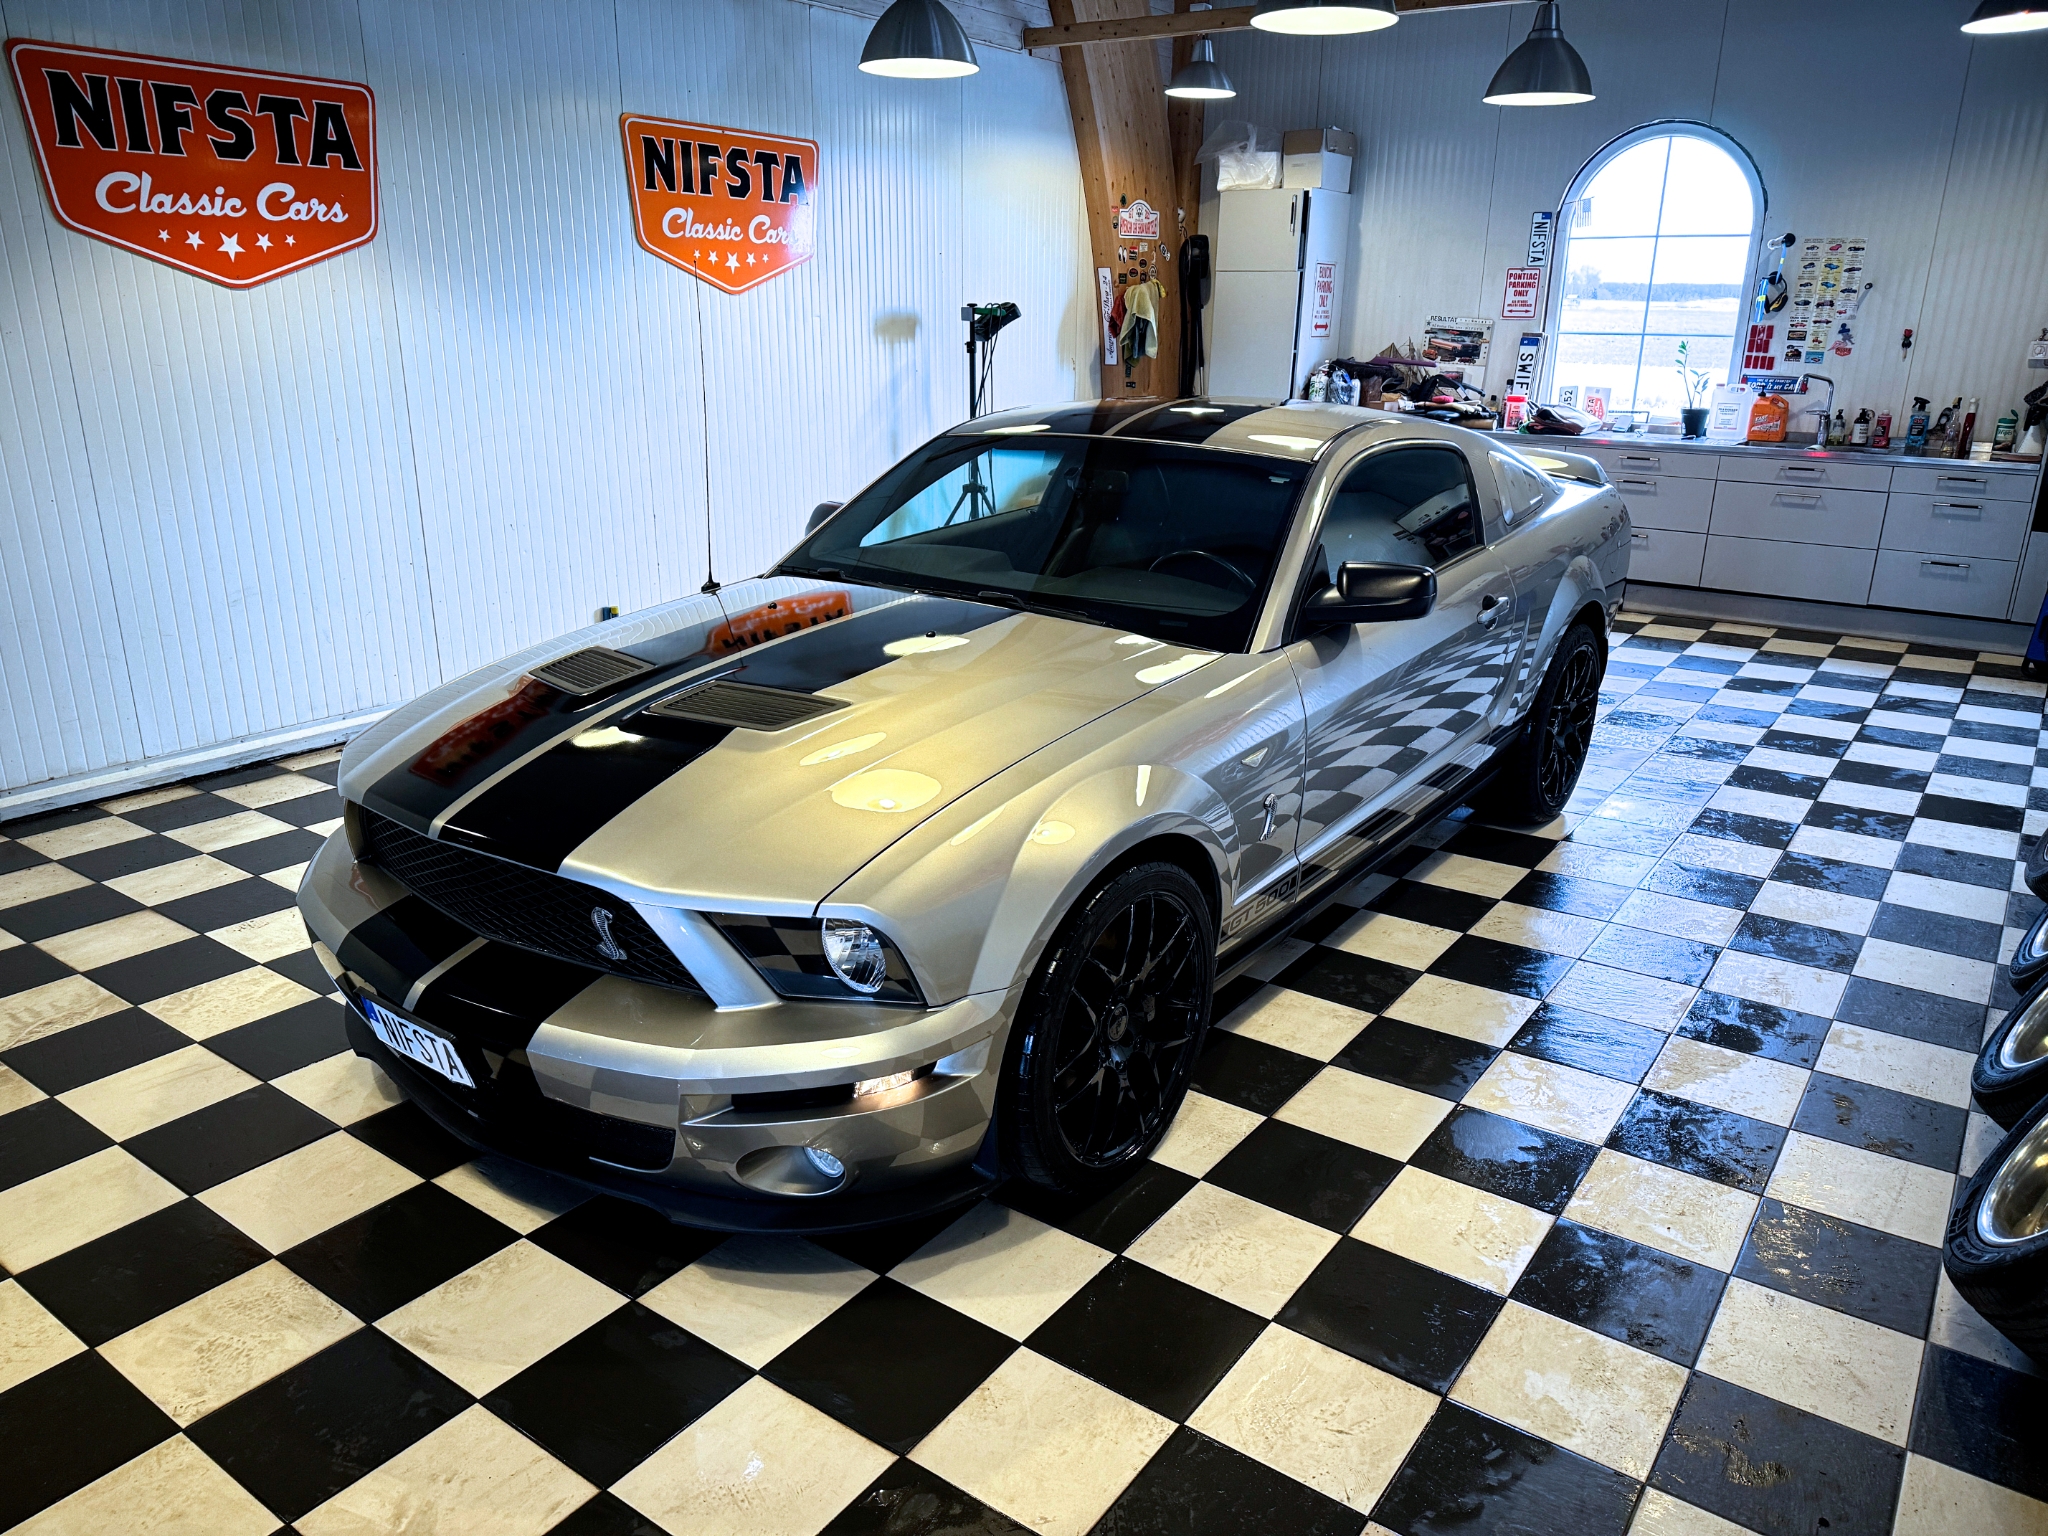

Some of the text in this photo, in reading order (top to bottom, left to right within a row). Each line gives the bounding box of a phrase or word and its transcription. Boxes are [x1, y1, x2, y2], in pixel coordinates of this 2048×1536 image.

[41, 67, 365, 172] NIFSTA
[640, 134, 810, 206] NIFSTA
[95, 170, 348, 223] Classic Cars
[662, 207, 800, 245] Classic Cars
[1530, 221, 1549, 263] NIFSTA
[1508, 281, 1536, 289] PARKING
[1509, 272, 1538, 281] PONTIAC
[1513, 289, 1529, 297] ONLY
[1516, 353, 1534, 396] SWIF
[376, 1009, 465, 1080] NIFSTA
